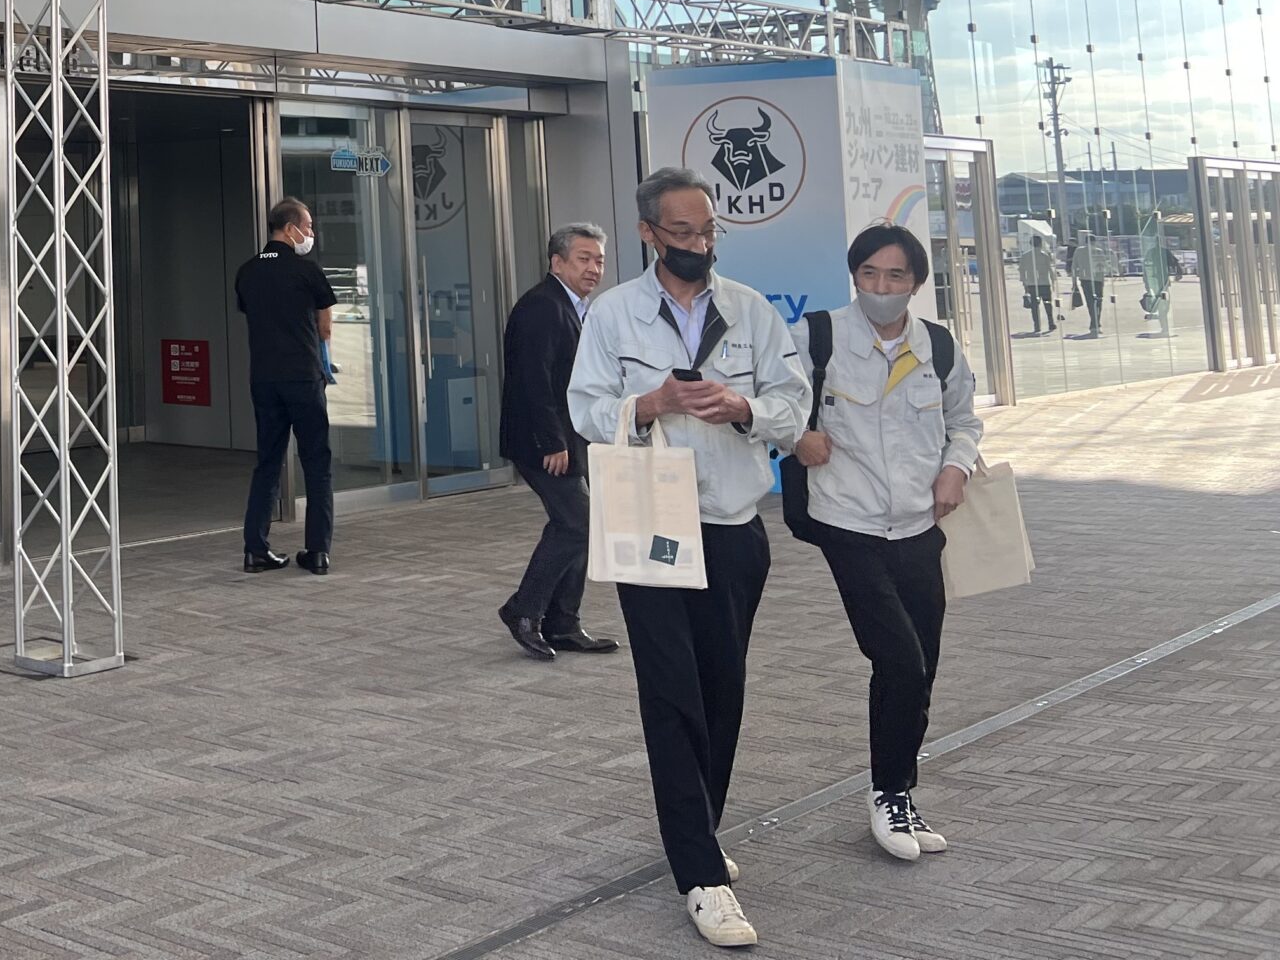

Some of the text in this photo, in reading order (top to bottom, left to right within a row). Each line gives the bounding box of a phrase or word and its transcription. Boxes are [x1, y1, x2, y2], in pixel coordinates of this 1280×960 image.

[845, 105, 872, 138] 九州
[847, 139, 919, 174] ジャパン建材
[849, 176, 883, 202] フェア
